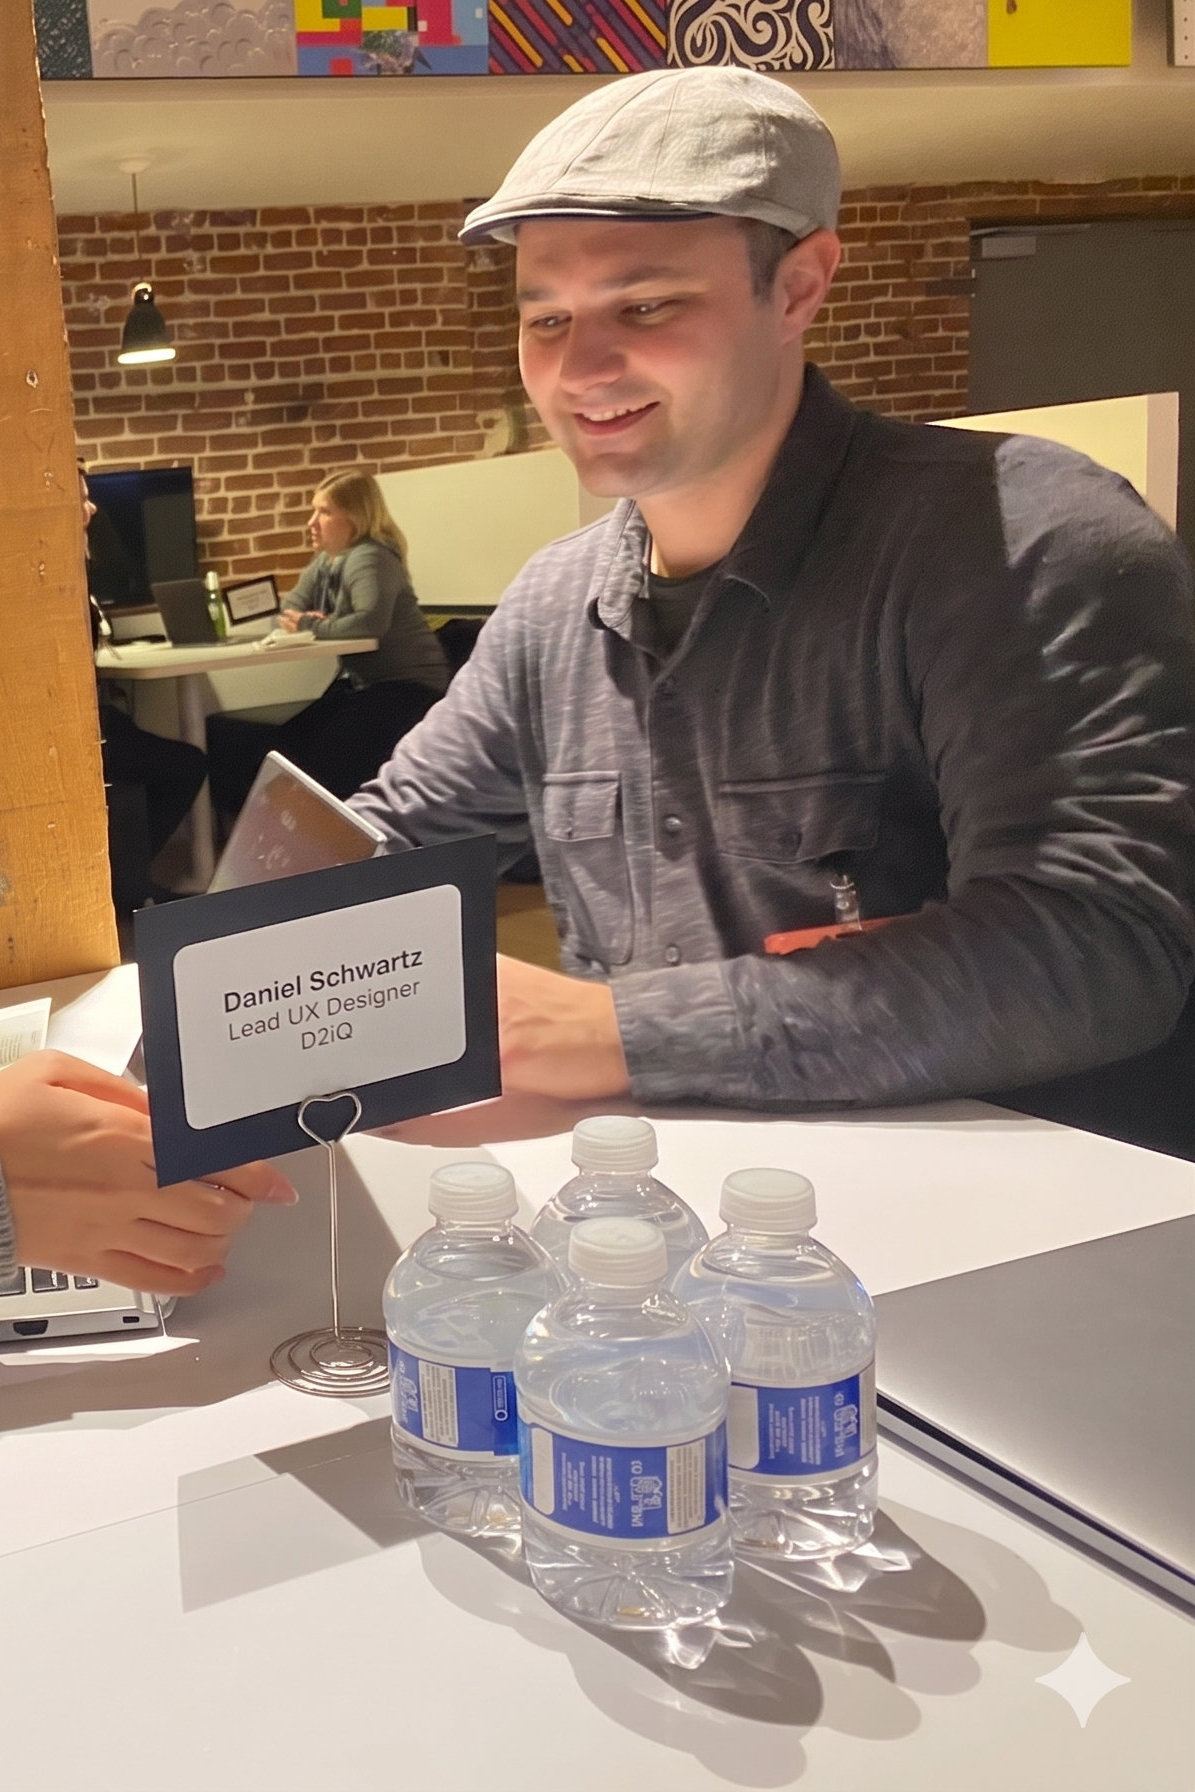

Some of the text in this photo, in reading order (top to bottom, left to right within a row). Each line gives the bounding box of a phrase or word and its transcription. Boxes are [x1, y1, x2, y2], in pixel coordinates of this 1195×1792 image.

[223, 950, 423, 1014] Daniel Schwartz
[228, 979, 421, 1041] Lead UX Designer
[301, 1021, 354, 1051] D2iQ
